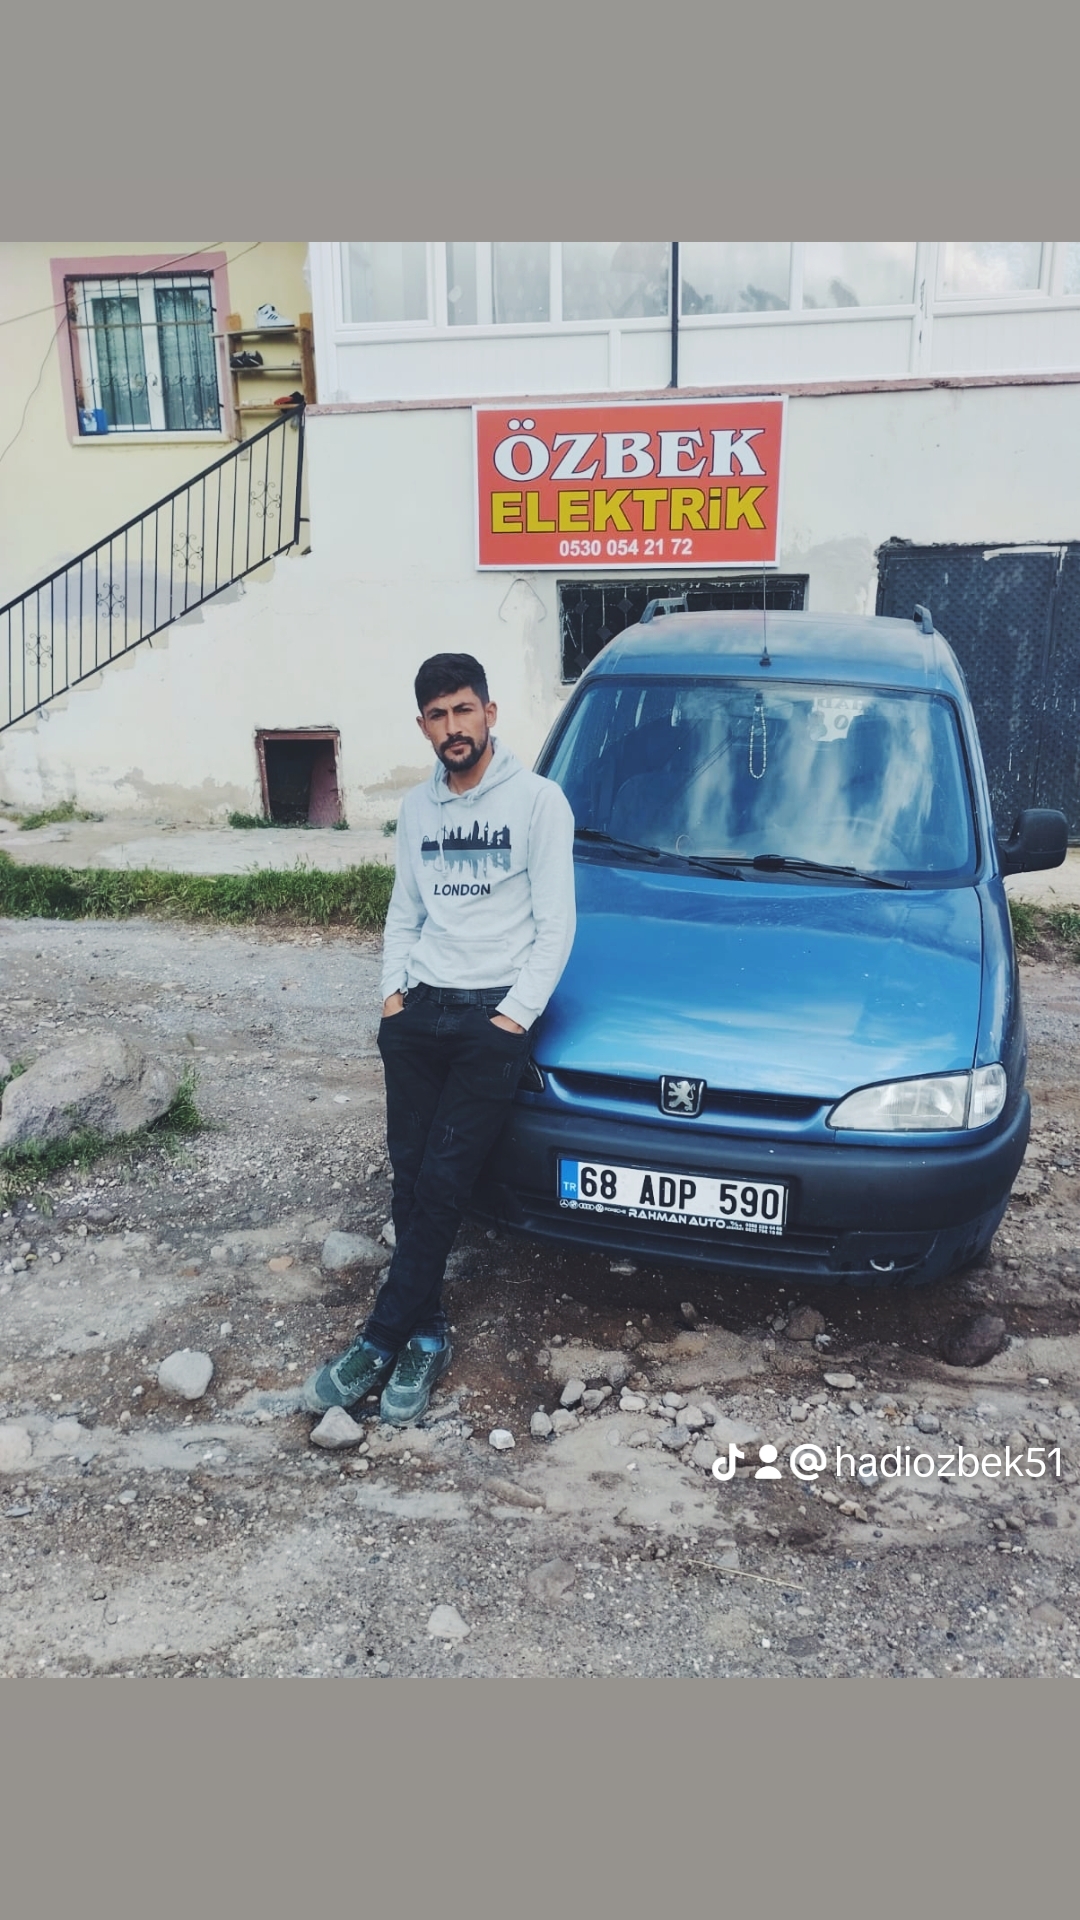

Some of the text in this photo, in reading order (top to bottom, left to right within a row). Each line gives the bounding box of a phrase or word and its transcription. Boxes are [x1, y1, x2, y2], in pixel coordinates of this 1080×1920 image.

[493, 418, 767, 482] ÖZBEK
[559, 538, 692, 556] 0530 054 21 72
[434, 884, 490, 896] LONDON
[563, 1182, 577, 1192] TR
[580, 1166, 780, 1220] 68 ADP 590
[628, 1208, 687, 1224] RAHMAN
[688, 1216, 726, 1229] AUTO
